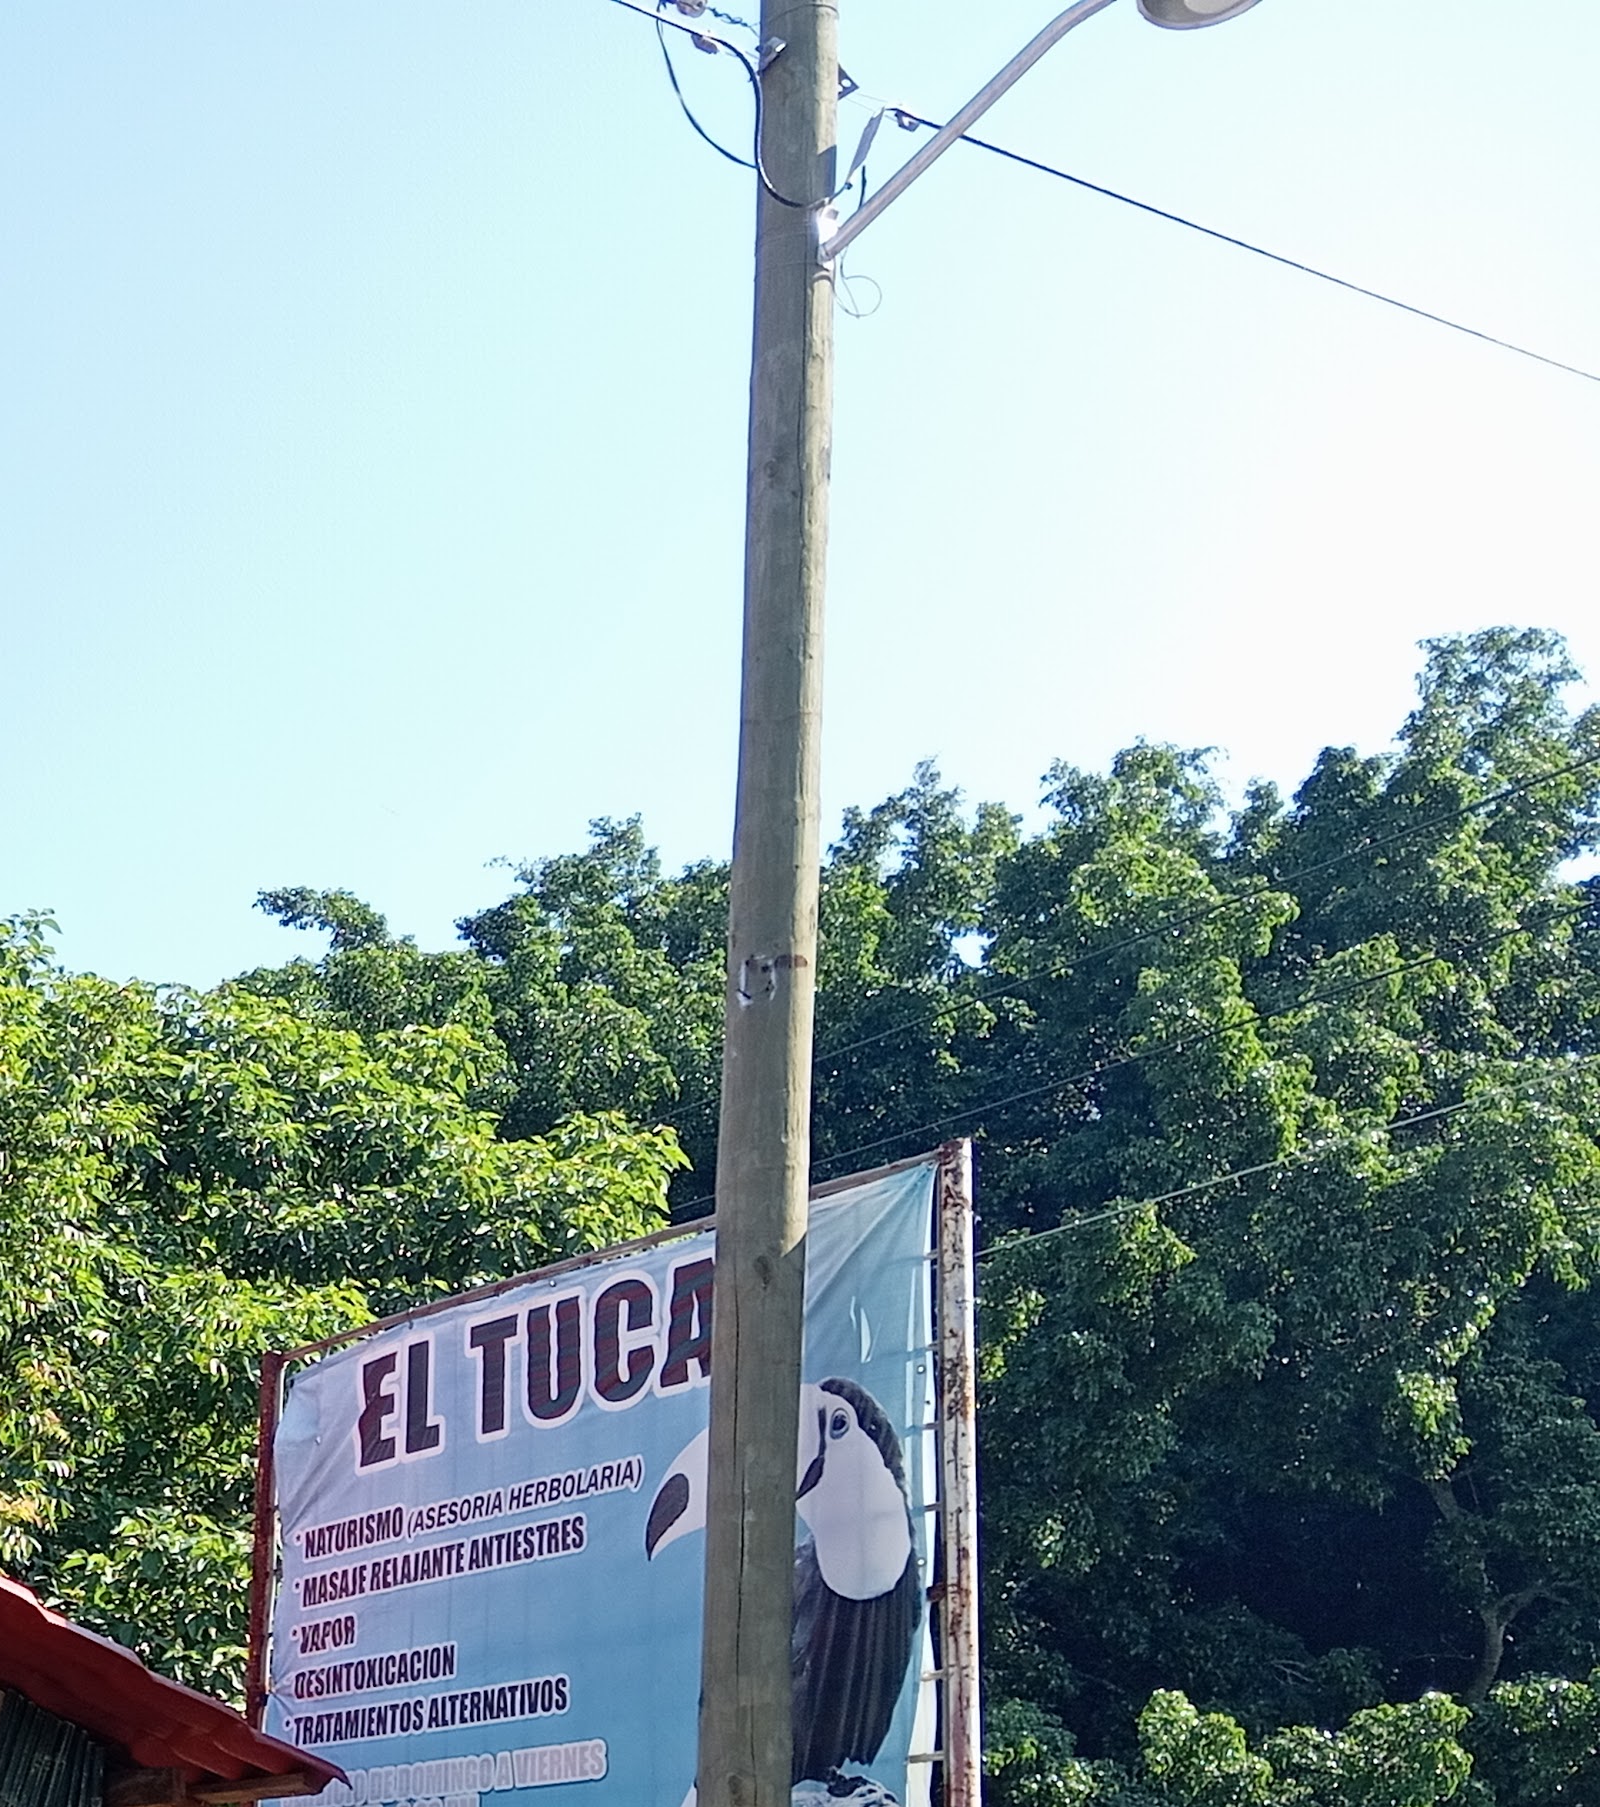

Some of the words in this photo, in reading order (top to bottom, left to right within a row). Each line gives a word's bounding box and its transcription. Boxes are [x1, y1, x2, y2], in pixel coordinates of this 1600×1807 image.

[358, 1341, 440, 1467] EL
[470, 1258, 714, 1434] TUCA
[305, 1507, 403, 1559] NATURISMO
[408, 1491, 502, 1538] (ASESORIA
[508, 1458, 643, 1512] HERBOLARIA)
[303, 1565, 367, 1607] MASAJE
[370, 1543, 464, 1591] RELAJANTE
[469, 1517, 584, 1570] ANTIESTRES
[300, 1616, 355, 1653] VAPOR
[294, 1645, 455, 1699] DESINTOXICACION
[294, 1700, 424, 1745] TRATAMIENTOS
[428, 1678, 568, 1729] ALTERNATIVOS
[398, 1756, 493, 1799] DOMINGO
[496, 1752, 511, 1788] A
[514, 1743, 605, 1784] VIERNES
